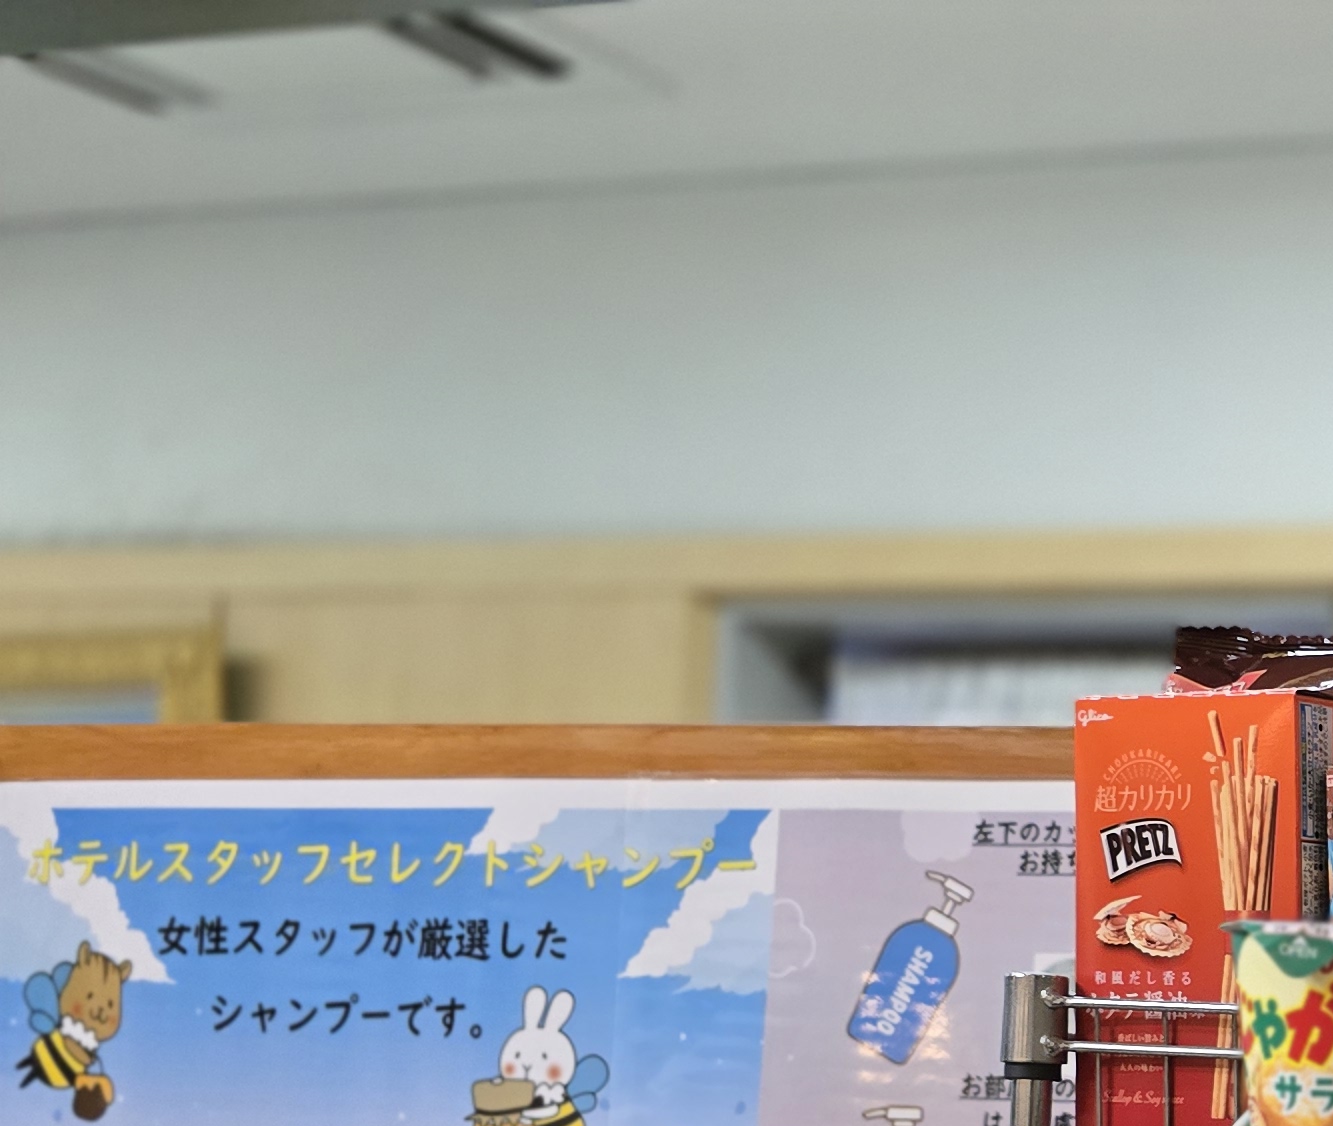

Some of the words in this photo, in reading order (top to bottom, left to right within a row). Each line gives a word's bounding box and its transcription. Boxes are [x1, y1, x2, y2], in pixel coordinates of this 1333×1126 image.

[1094, 783, 1192, 814] 超カリカリ
[28, 838, 759, 891] ホテルスタッフセレクトシャンプー
[1106, 823, 1175, 874] PRETZ
[156, 916, 569, 962] 女性スタッフが厳選した
[877, 944, 935, 1037] SHAMPOO
[1094, 969, 1192, 987] 和風だし香る
[211, 992, 486, 1041] シャンプーです。
